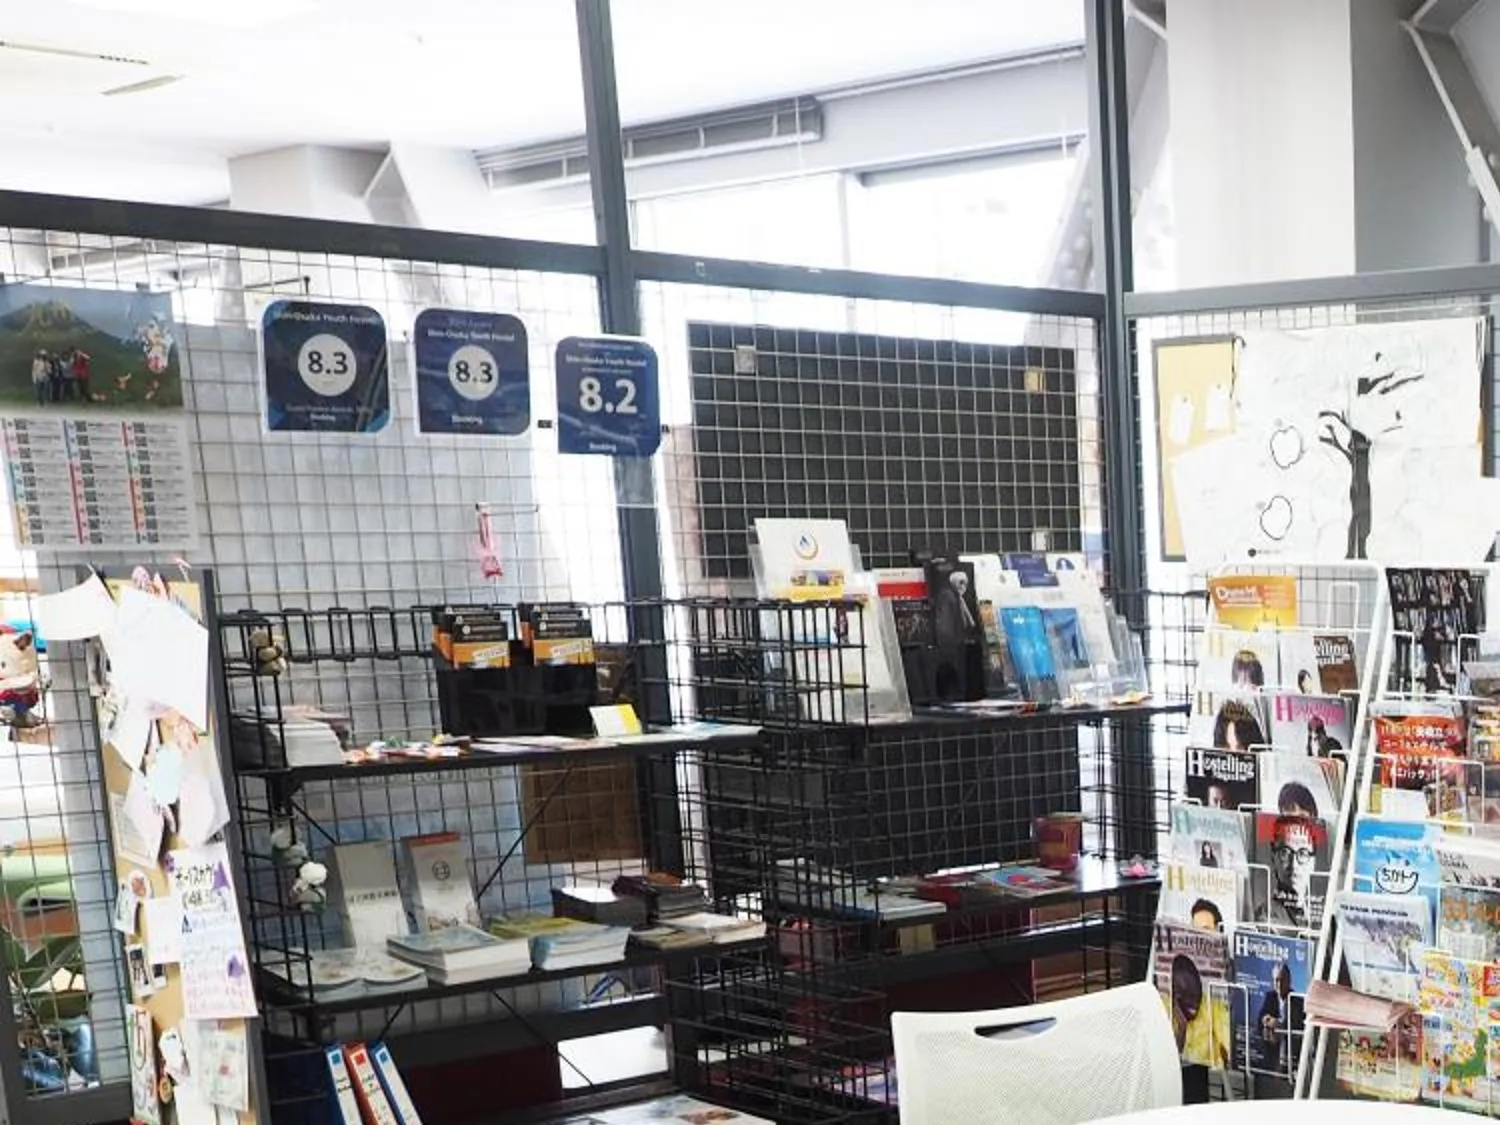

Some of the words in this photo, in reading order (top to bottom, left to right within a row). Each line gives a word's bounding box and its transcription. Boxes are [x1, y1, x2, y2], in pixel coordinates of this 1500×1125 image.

[307, 351, 349, 375] 8.3
[455, 360, 493, 383] 8.3
[579, 376, 638, 413] 8.2
[1187, 750, 1255, 779] Hostelling
